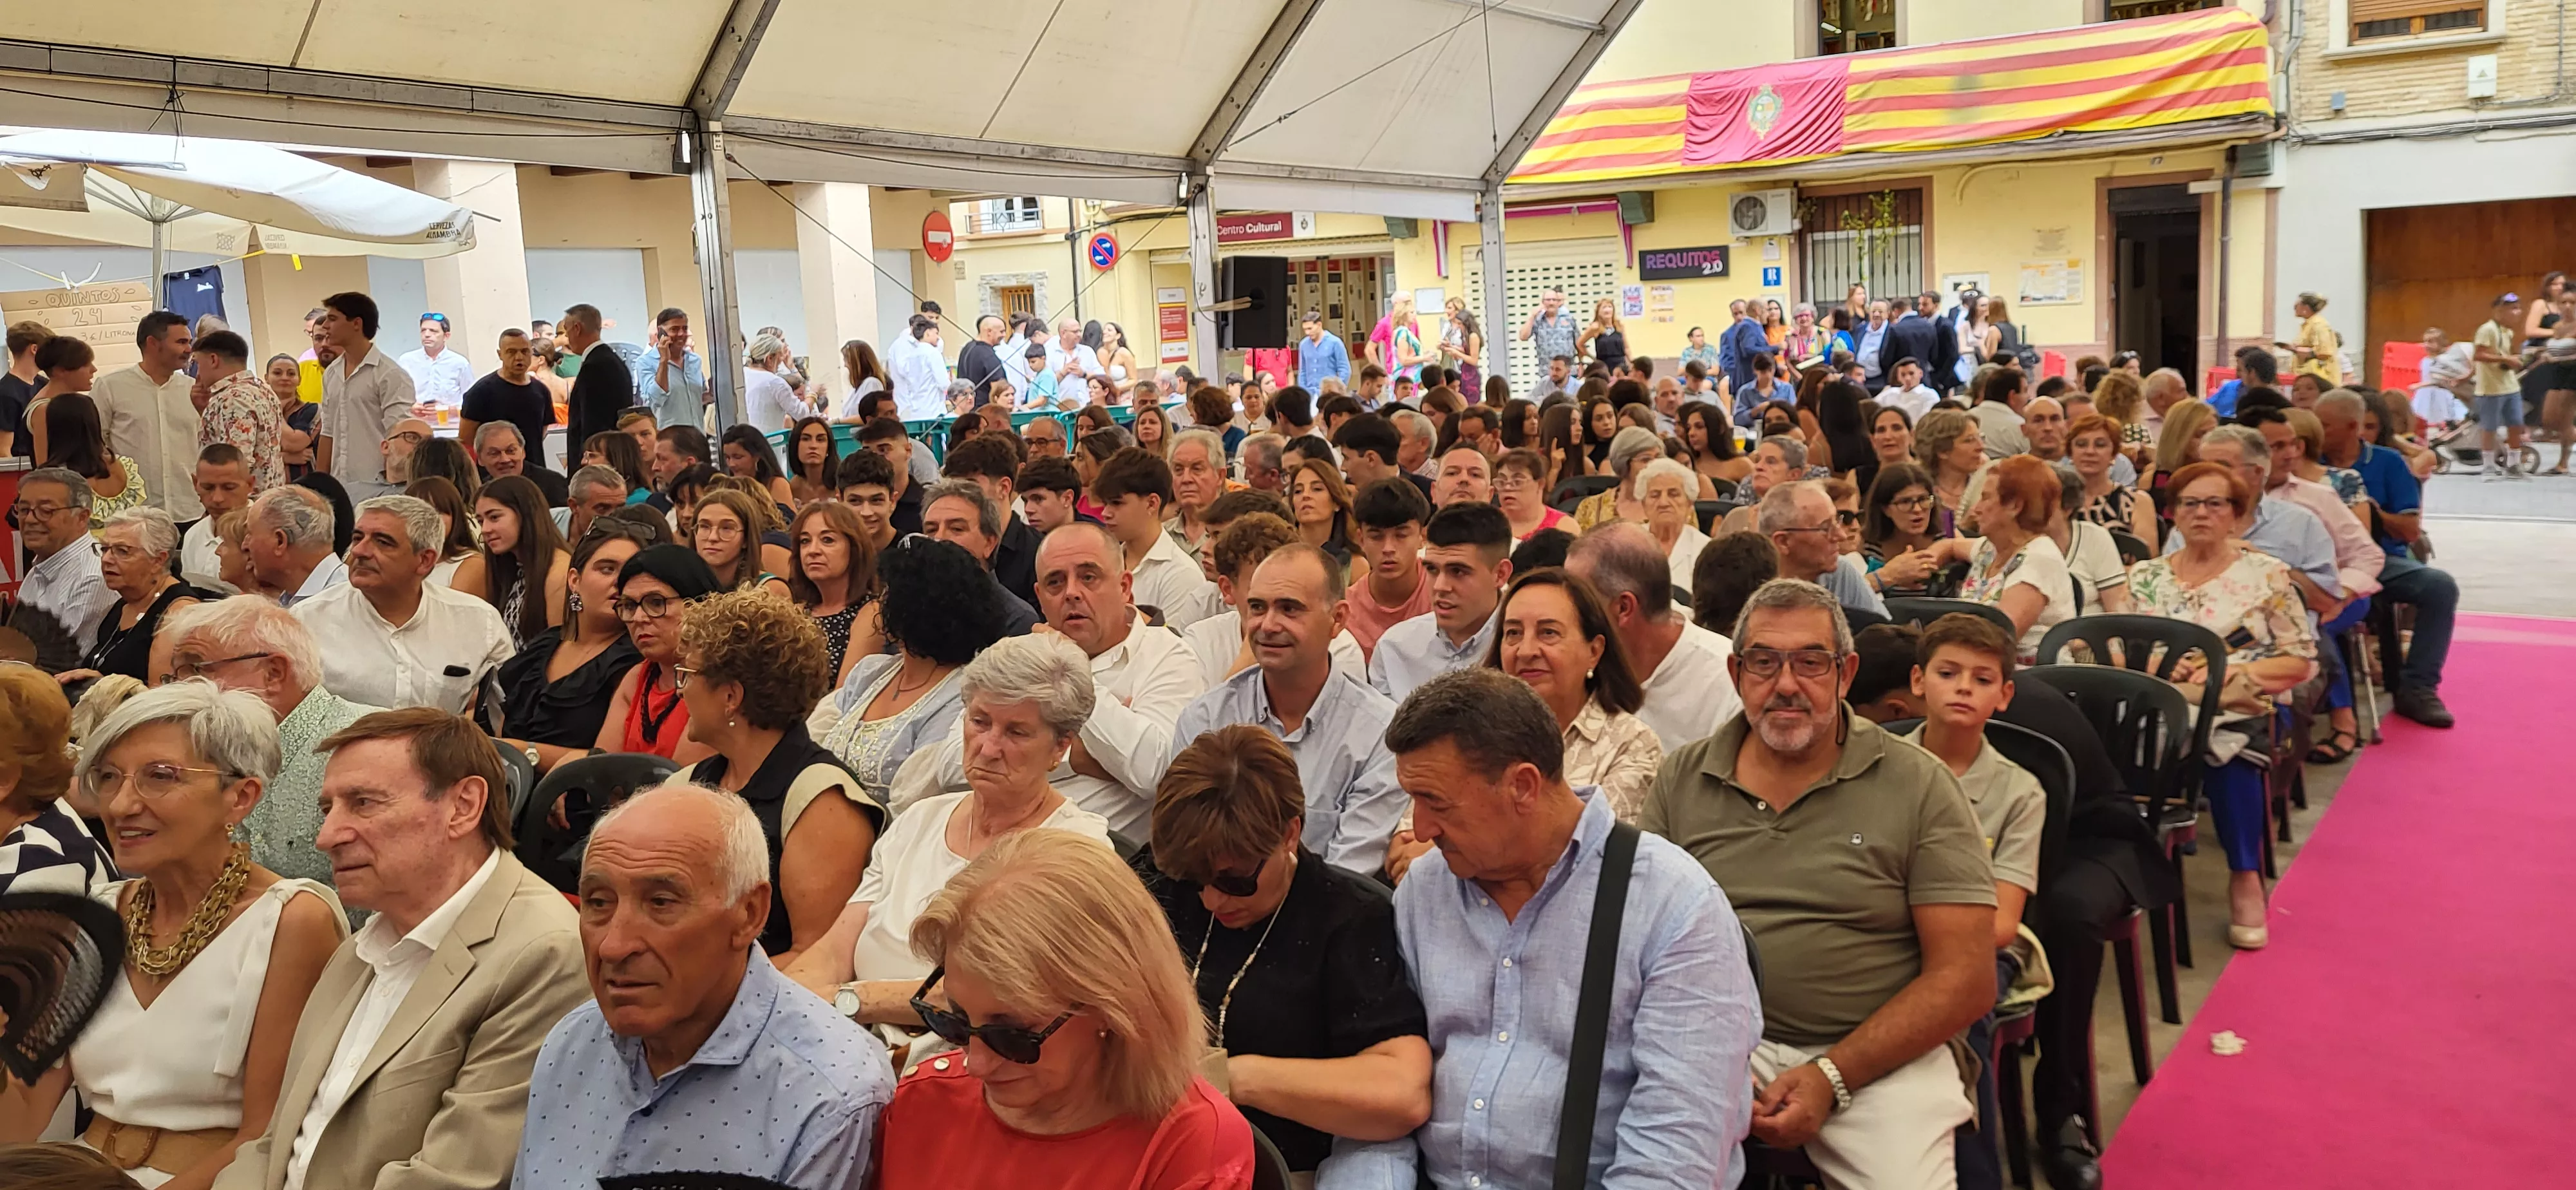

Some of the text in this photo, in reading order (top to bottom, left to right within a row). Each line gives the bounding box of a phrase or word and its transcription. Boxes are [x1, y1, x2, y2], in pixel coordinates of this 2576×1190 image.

[1217, 220, 1282, 236] Centro Cultural
[1646, 250, 1720, 269] REQUITOS
[1701, 259, 1723, 275] 2.0
[46, 288, 120, 308] QUINTOS
[72, 308, 102, 326] 24
